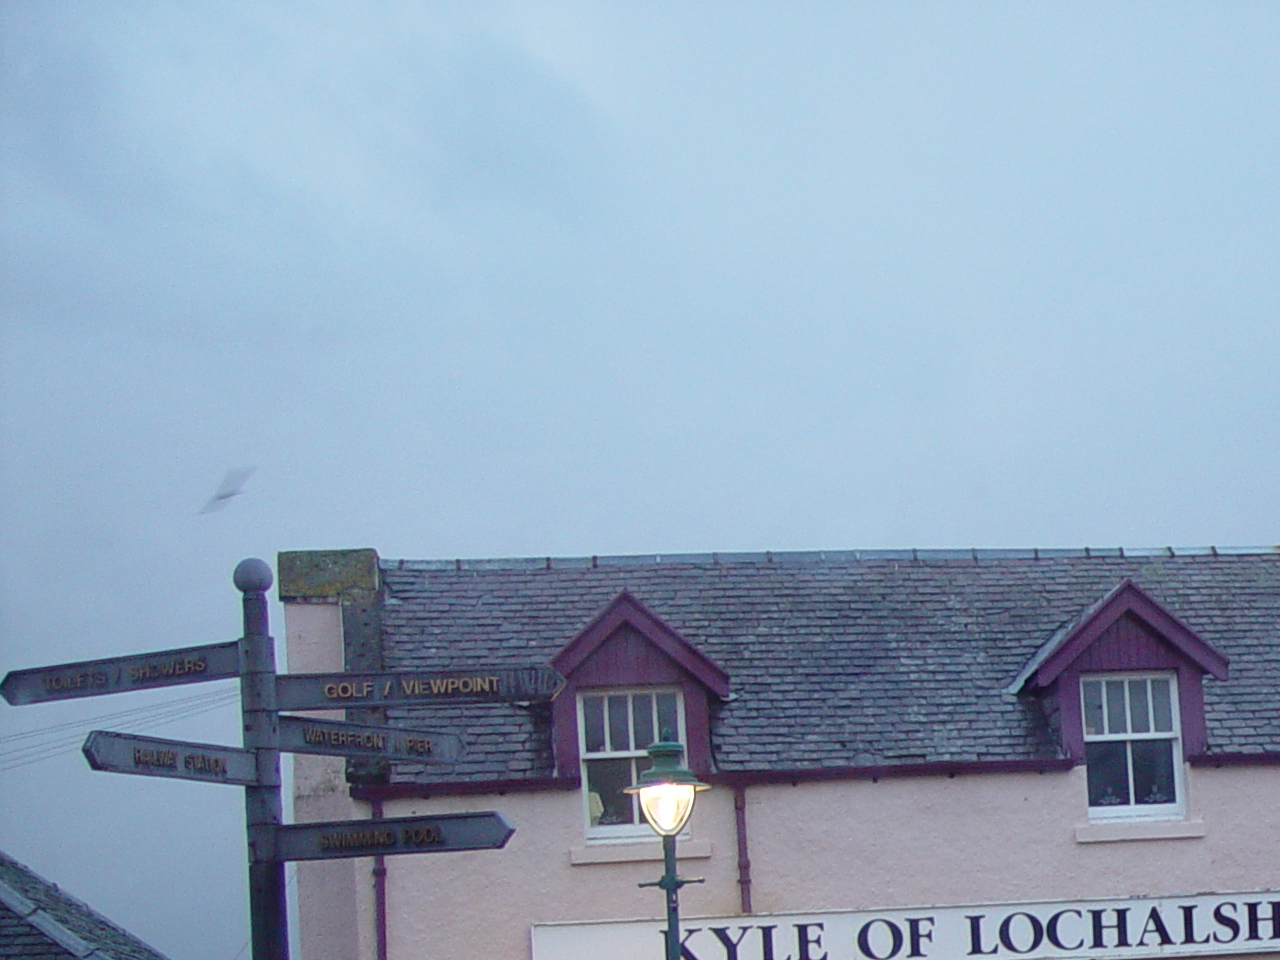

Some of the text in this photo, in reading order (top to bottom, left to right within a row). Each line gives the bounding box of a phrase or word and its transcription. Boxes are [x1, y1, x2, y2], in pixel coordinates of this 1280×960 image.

[128, 657, 206, 682] SHOWERS
[324, 682, 374, 698] GOLF
[402, 676, 500, 696] VIEWPOINT
[303, 726, 387, 749] WATERFRONT
[406, 737, 433, 754] PIER
[320, 827, 443, 850] SWIMMING POOL
[856, 916, 935, 960] OF
